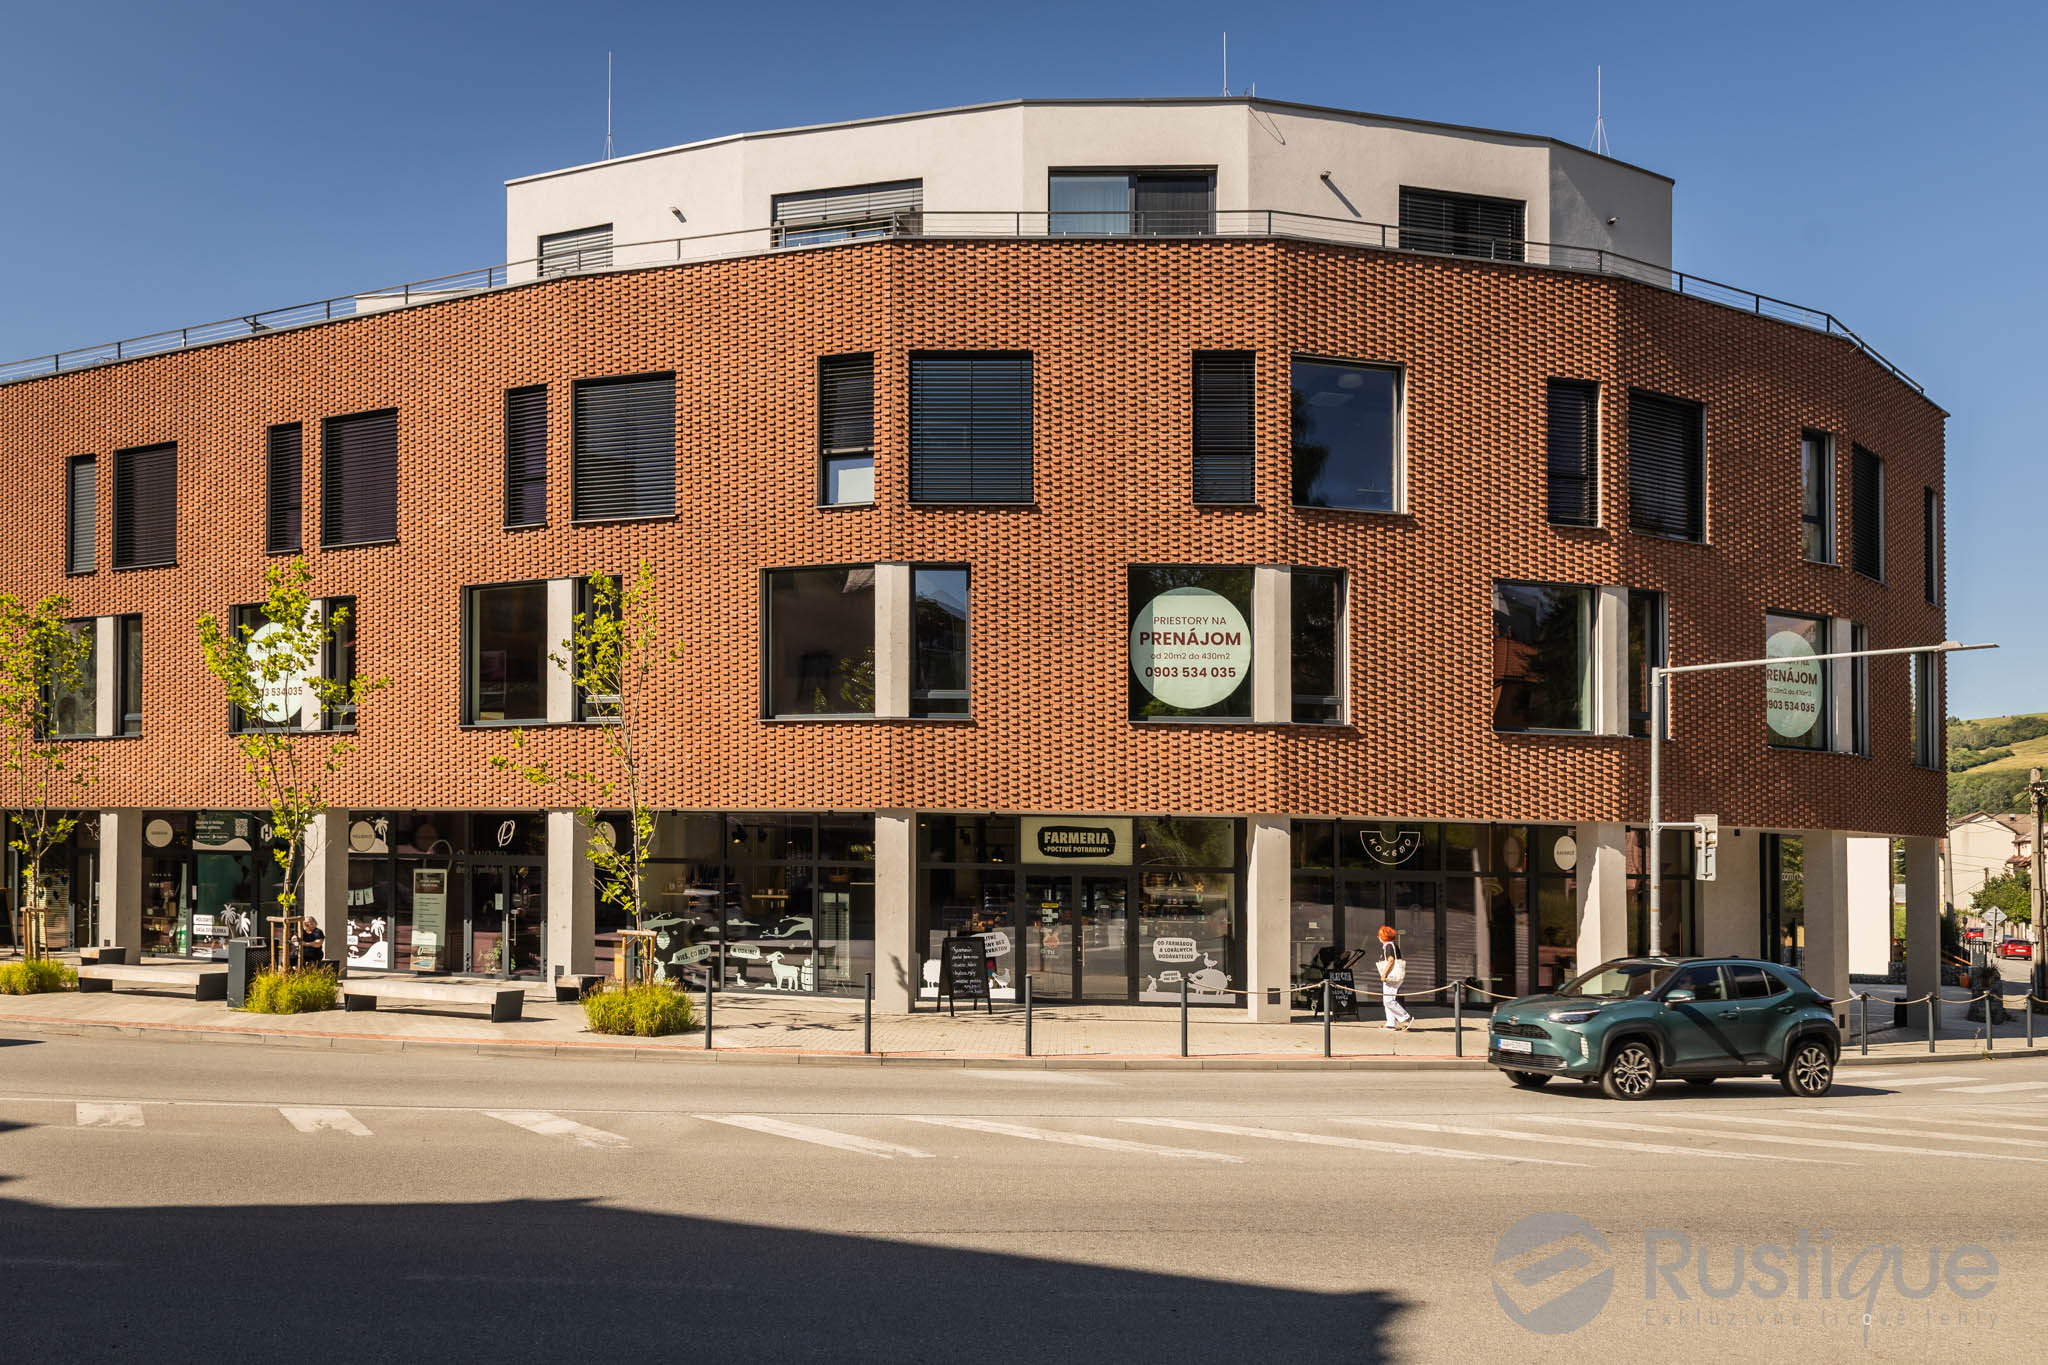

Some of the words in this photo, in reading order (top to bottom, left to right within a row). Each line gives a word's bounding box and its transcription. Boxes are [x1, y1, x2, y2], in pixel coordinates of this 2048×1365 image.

[1153, 616, 1209, 625] PRIESTORY
[1211, 616, 1227, 625] NA
[1140, 627, 1241, 646] PRENÁJOM
[1150, 652, 1162, 660] od
[1163, 652, 1187, 660] 20m2
[1188, 652, 1200, 660] do
[1201, 652, 1231, 660] 430m2
[1145, 666, 1179, 678] 0903
[1182, 666, 1208, 678] 534
[1210, 666, 1236, 678] 035
[1766, 667, 1818, 685] RENÁJOM
[287, 686, 303, 696] 035
[1767, 699, 1783, 710] 903
[1784, 701, 1799, 711] 534
[1800, 702, 1816, 713] 035
[1044, 831, 1109, 845] FARMERIA
[1073, 846, 1107, 854] POTRAVINY
